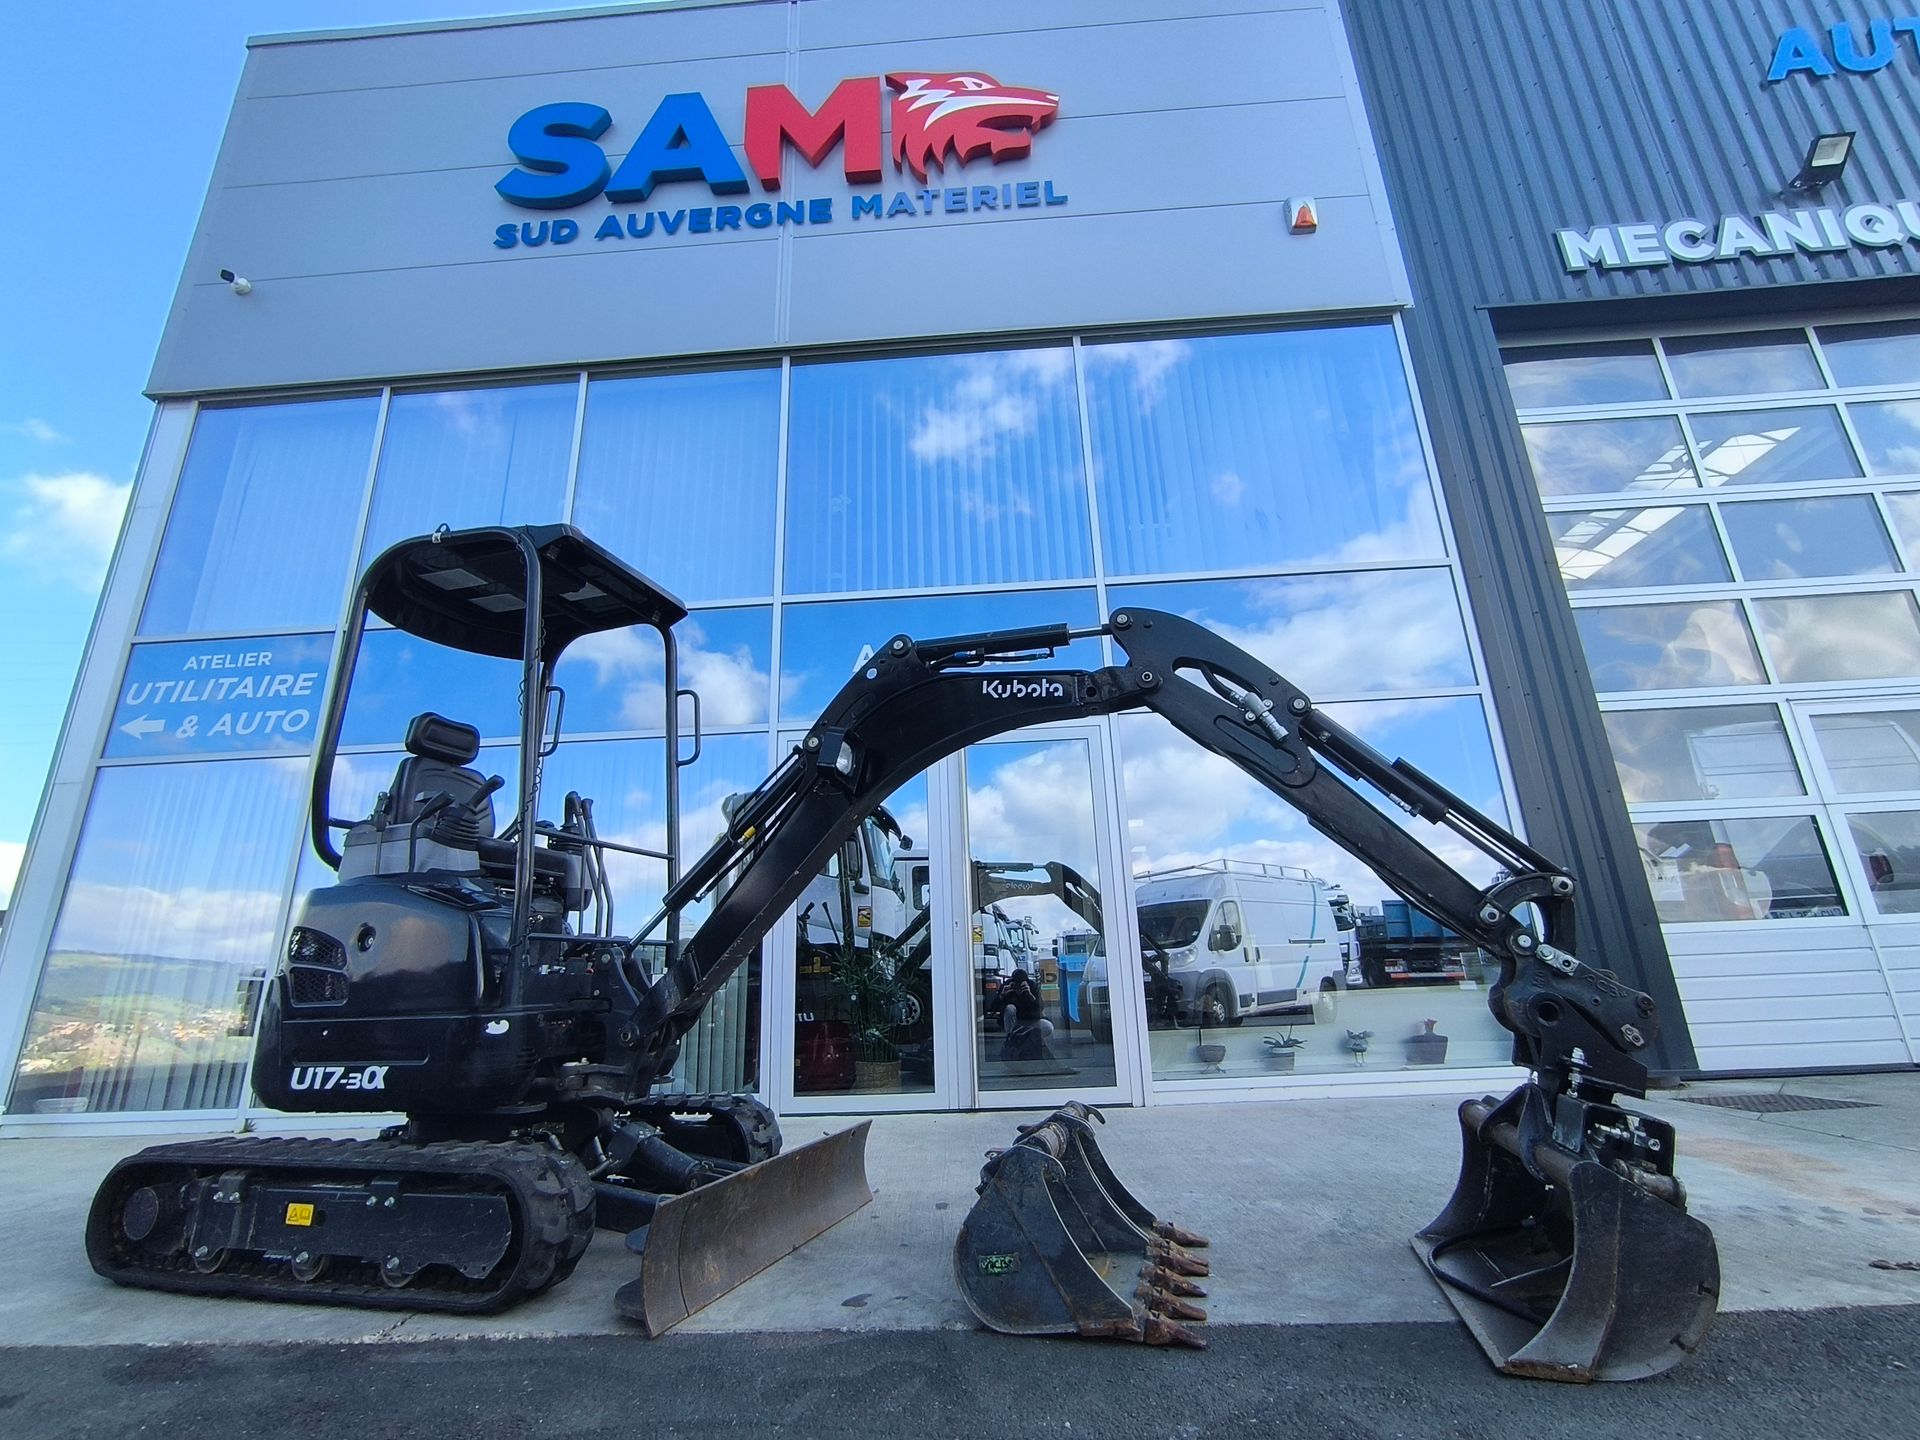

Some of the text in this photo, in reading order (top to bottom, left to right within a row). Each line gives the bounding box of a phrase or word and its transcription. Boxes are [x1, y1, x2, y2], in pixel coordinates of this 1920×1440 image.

[493, 76, 883, 211] SAM
[493, 180, 1069, 249] SUD AUVERGNE MATERIEL
[183, 651, 272, 671] ATELIER
[126, 672, 318, 705] UTILITAIRE
[175, 708, 310, 739] & AUTO
